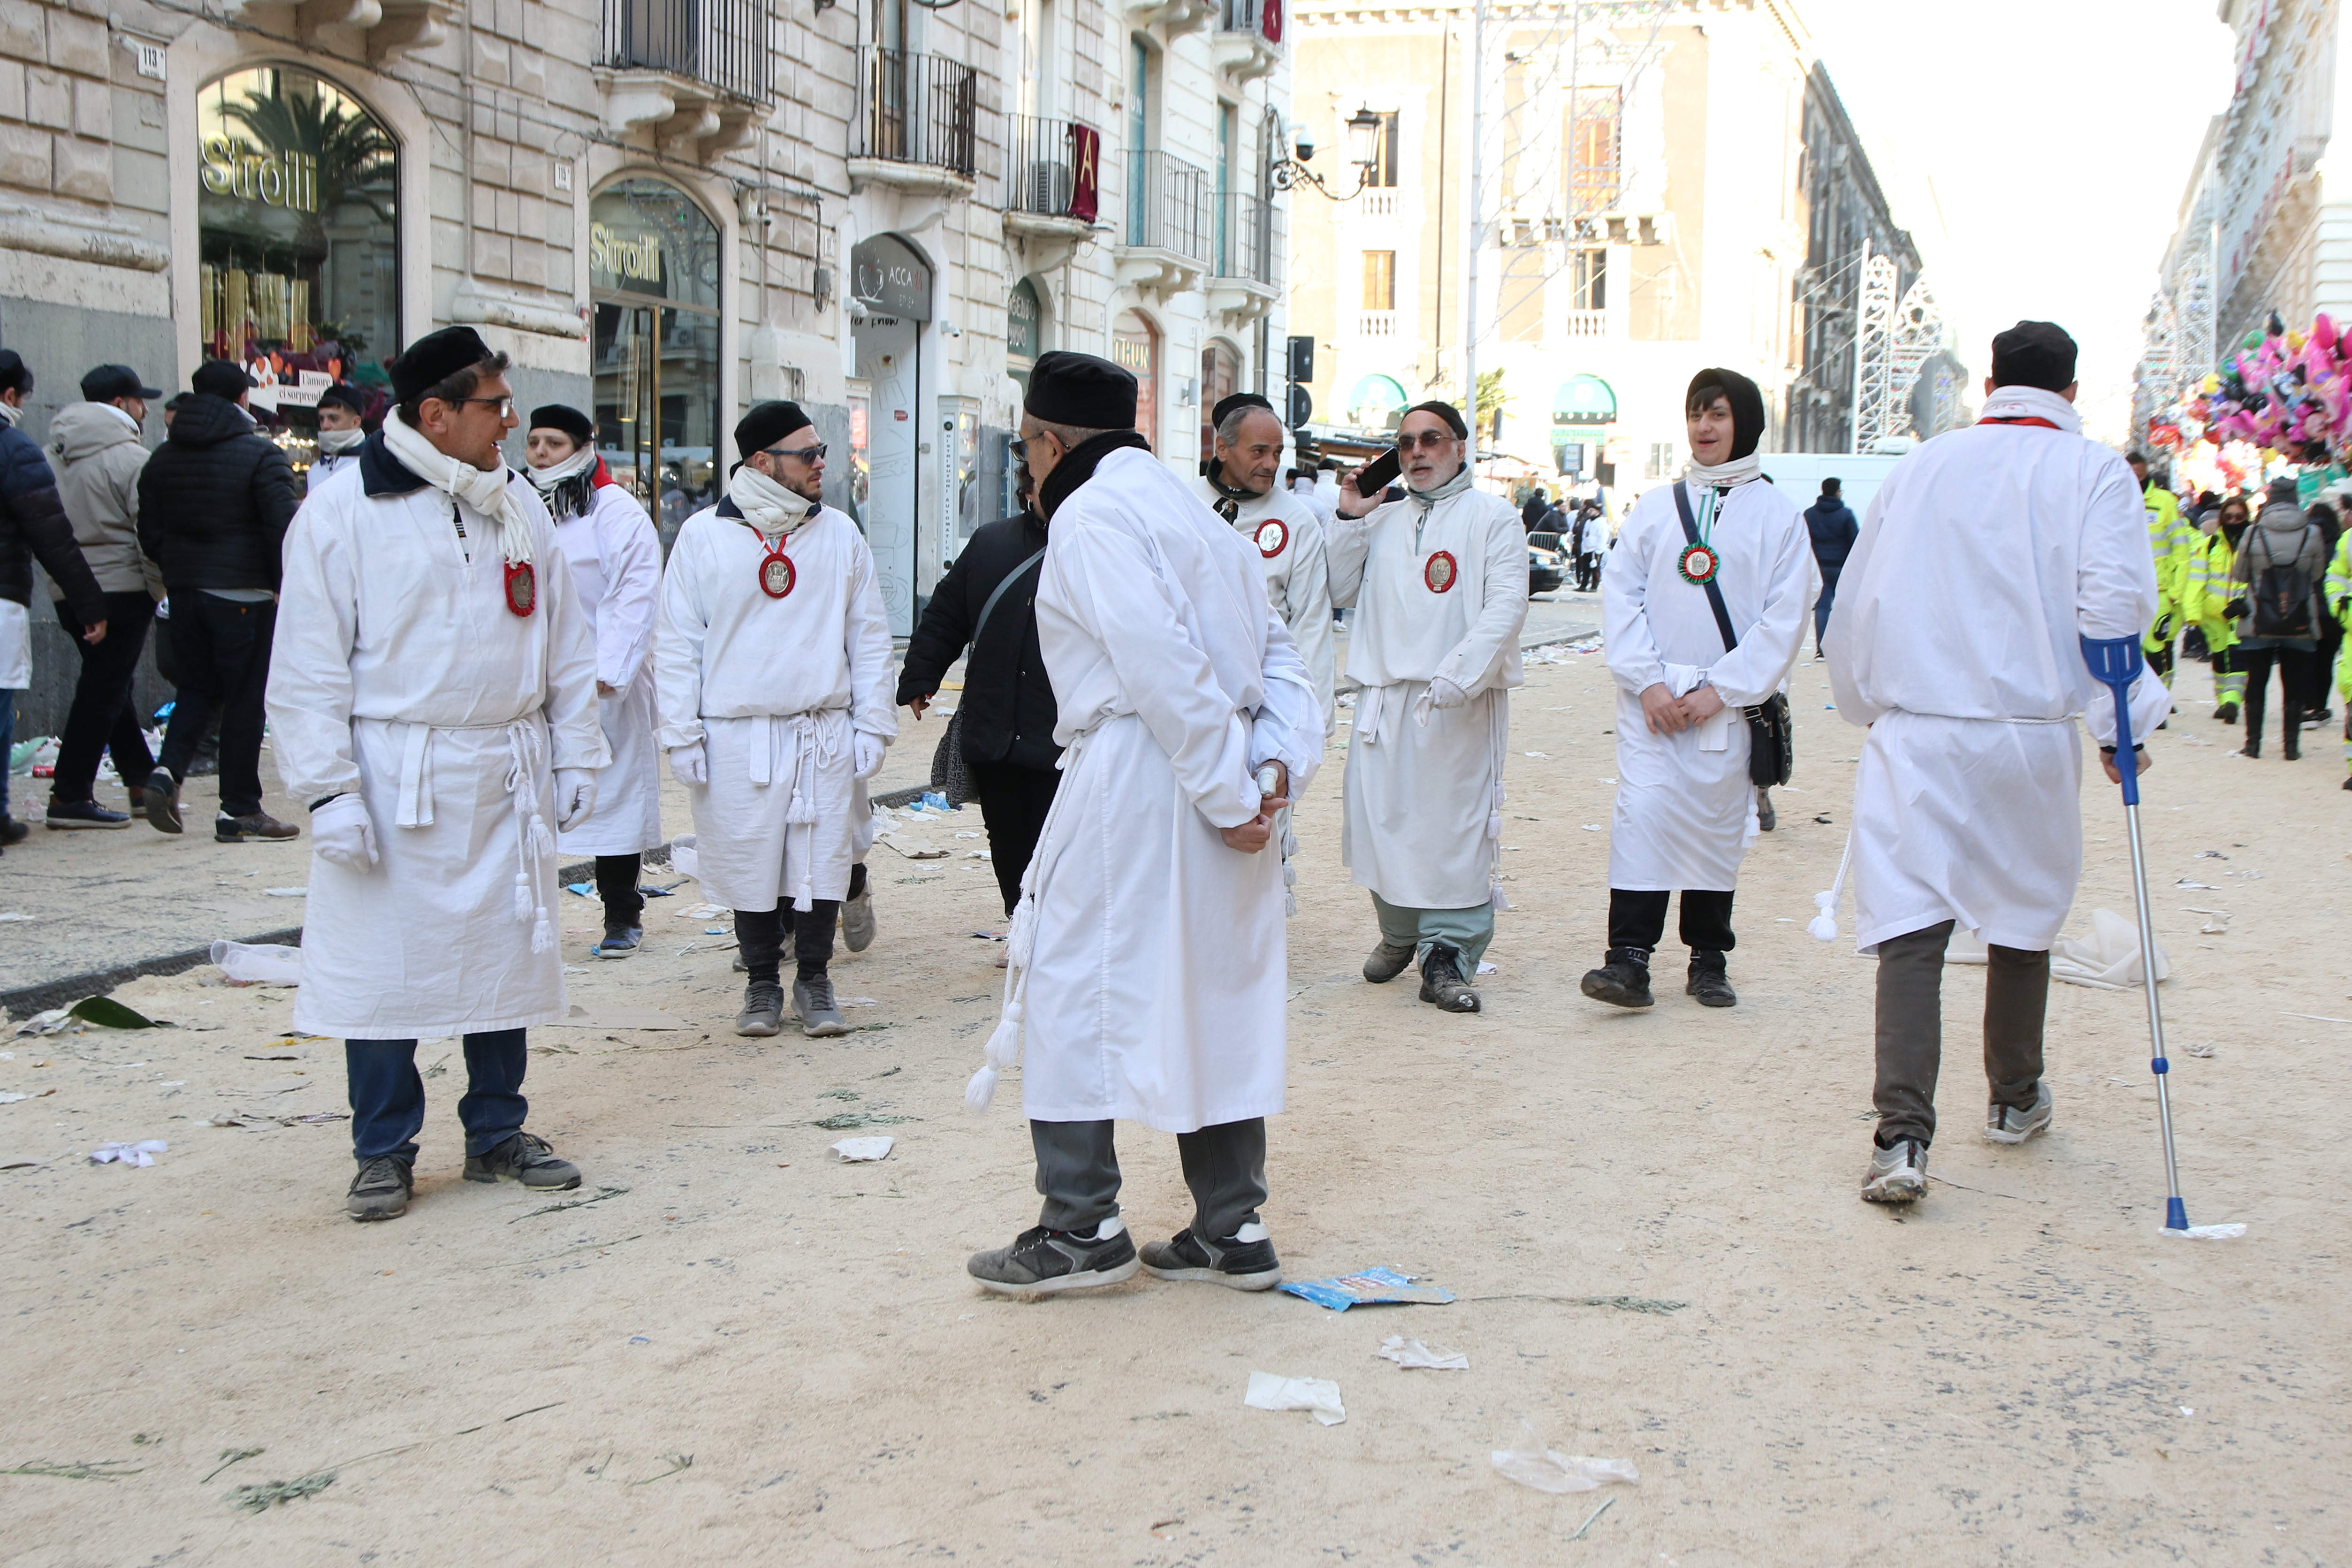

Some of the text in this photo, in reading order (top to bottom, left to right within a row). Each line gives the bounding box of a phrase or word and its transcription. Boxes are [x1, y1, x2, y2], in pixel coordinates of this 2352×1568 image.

[144, 46, 157, 67] 113
[1080, 128, 1095, 191] A
[201, 131, 317, 213] Stroili
[590, 221, 660, 282] Stroili
[889, 266, 913, 287] ACCA
[302, 373, 331, 388] L'amore
[287, 390, 323, 404] sorprend
